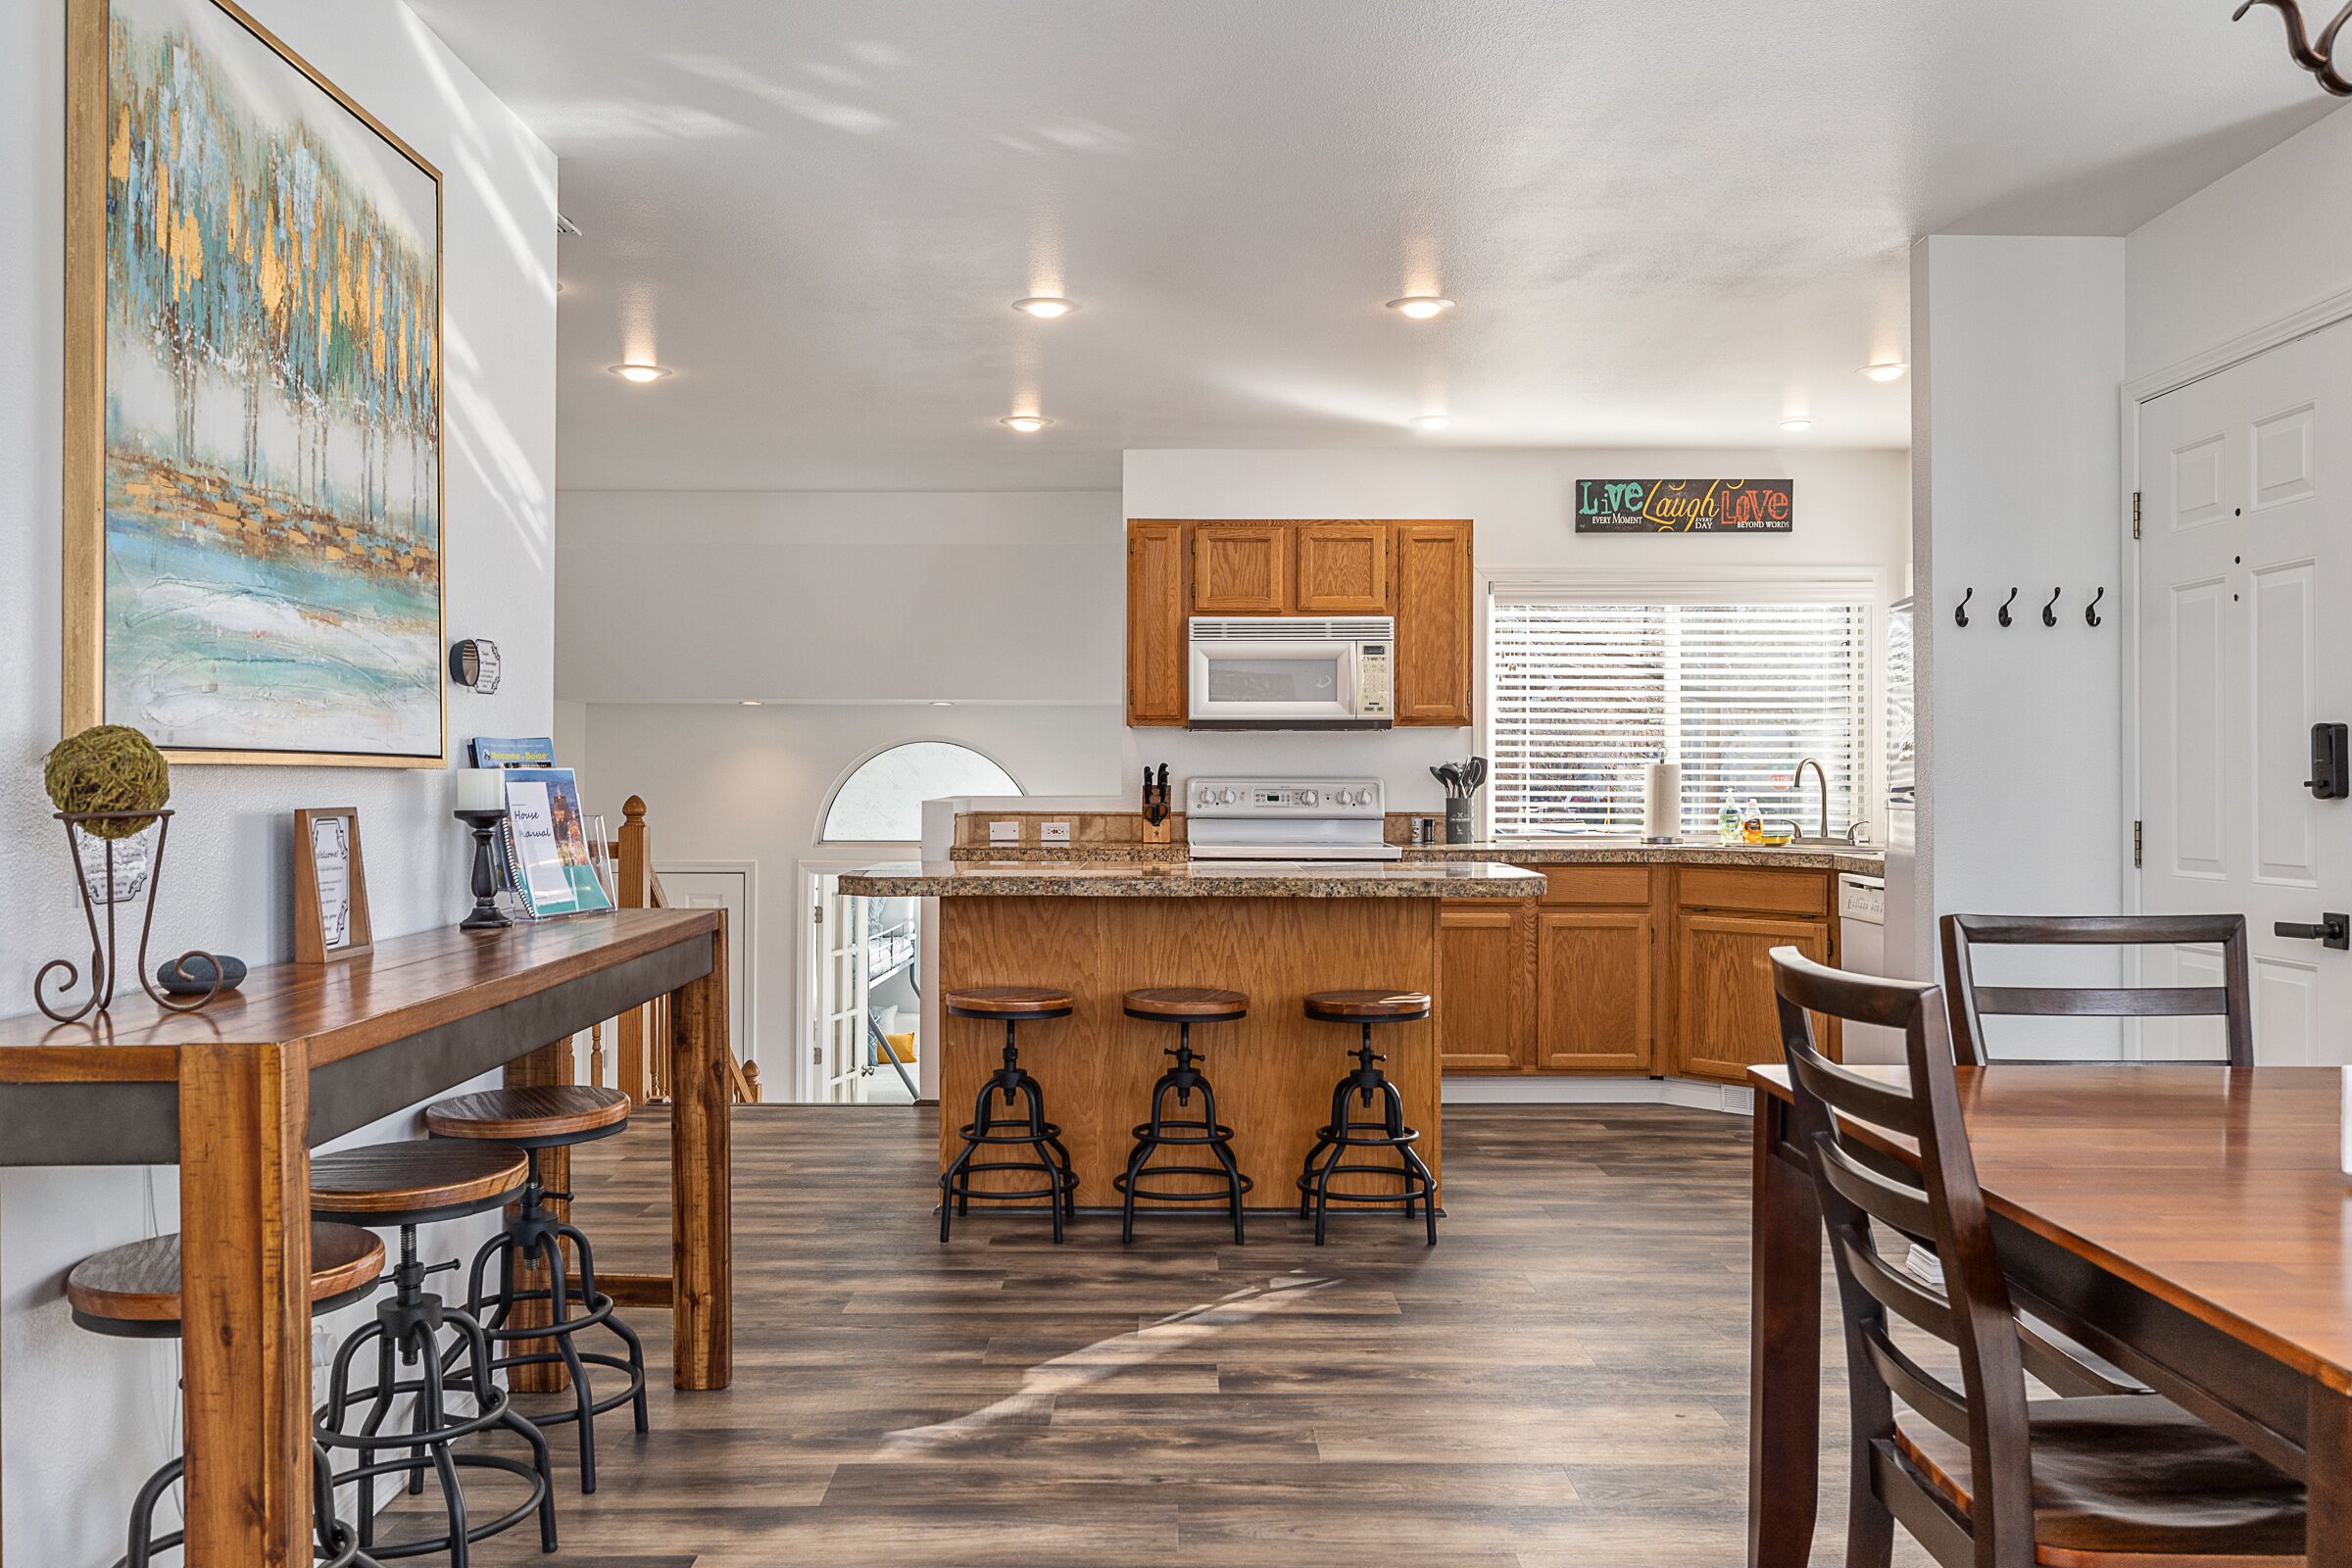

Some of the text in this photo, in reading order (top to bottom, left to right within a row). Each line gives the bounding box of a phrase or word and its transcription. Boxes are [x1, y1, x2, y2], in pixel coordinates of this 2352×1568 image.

[1642, 478, 1721, 533] Laugh
[1612, 513, 1643, 524] MOMENT
[514, 809, 539, 820] House
